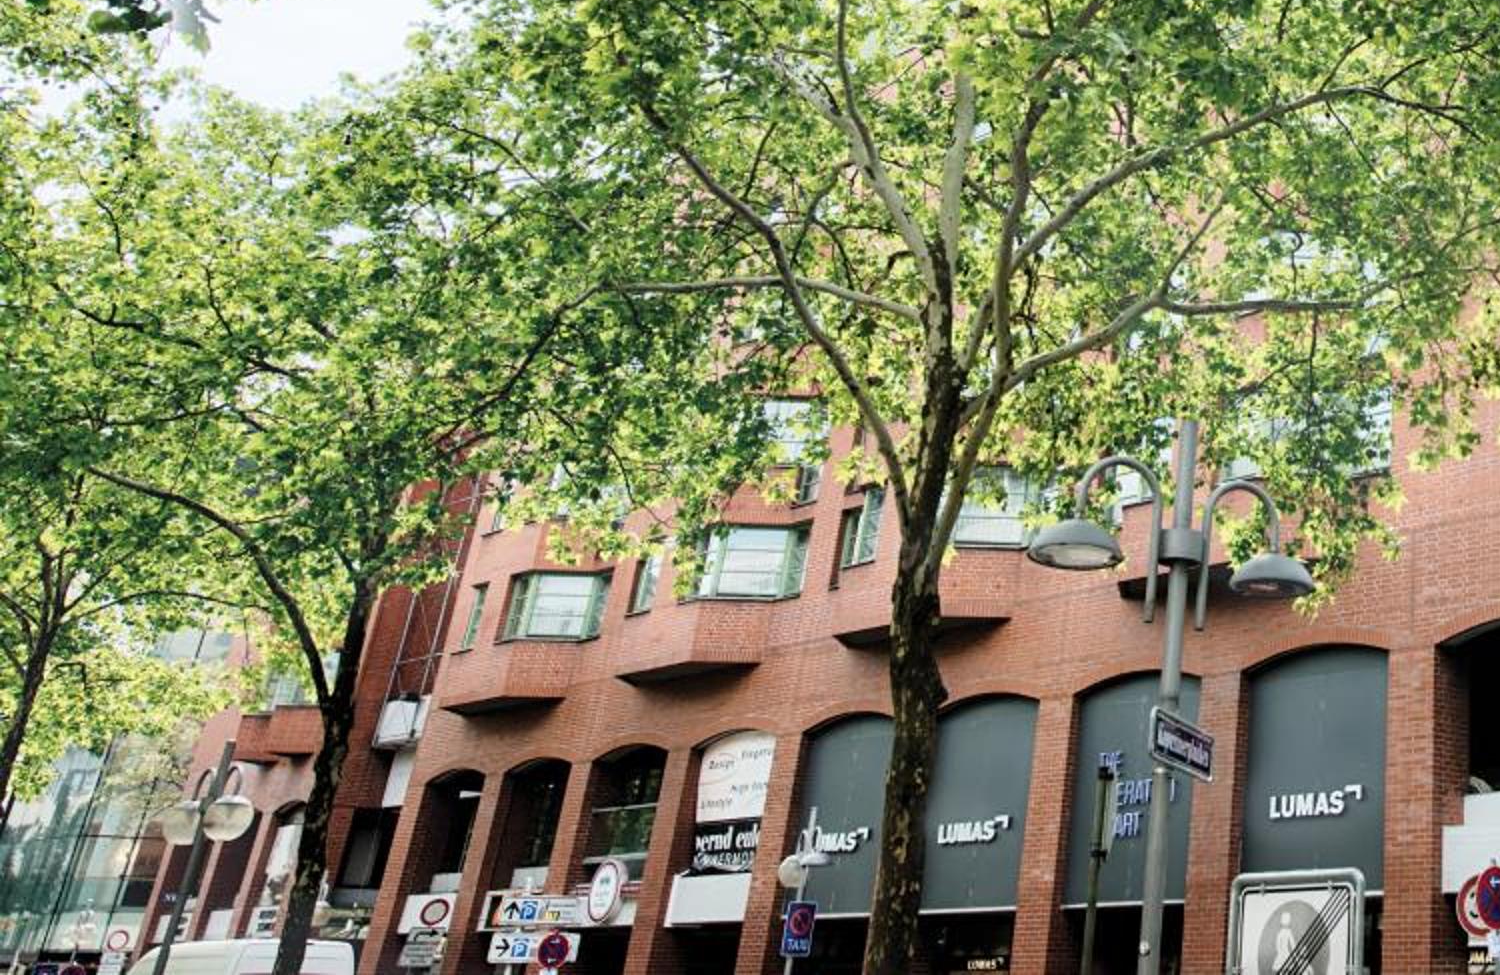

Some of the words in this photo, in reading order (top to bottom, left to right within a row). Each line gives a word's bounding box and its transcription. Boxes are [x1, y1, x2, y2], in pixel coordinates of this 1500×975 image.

[1268, 790, 1345, 819] LUMAS
[937, 820, 996, 844] LUMAS
[966, 958, 997, 971] LUMAS
